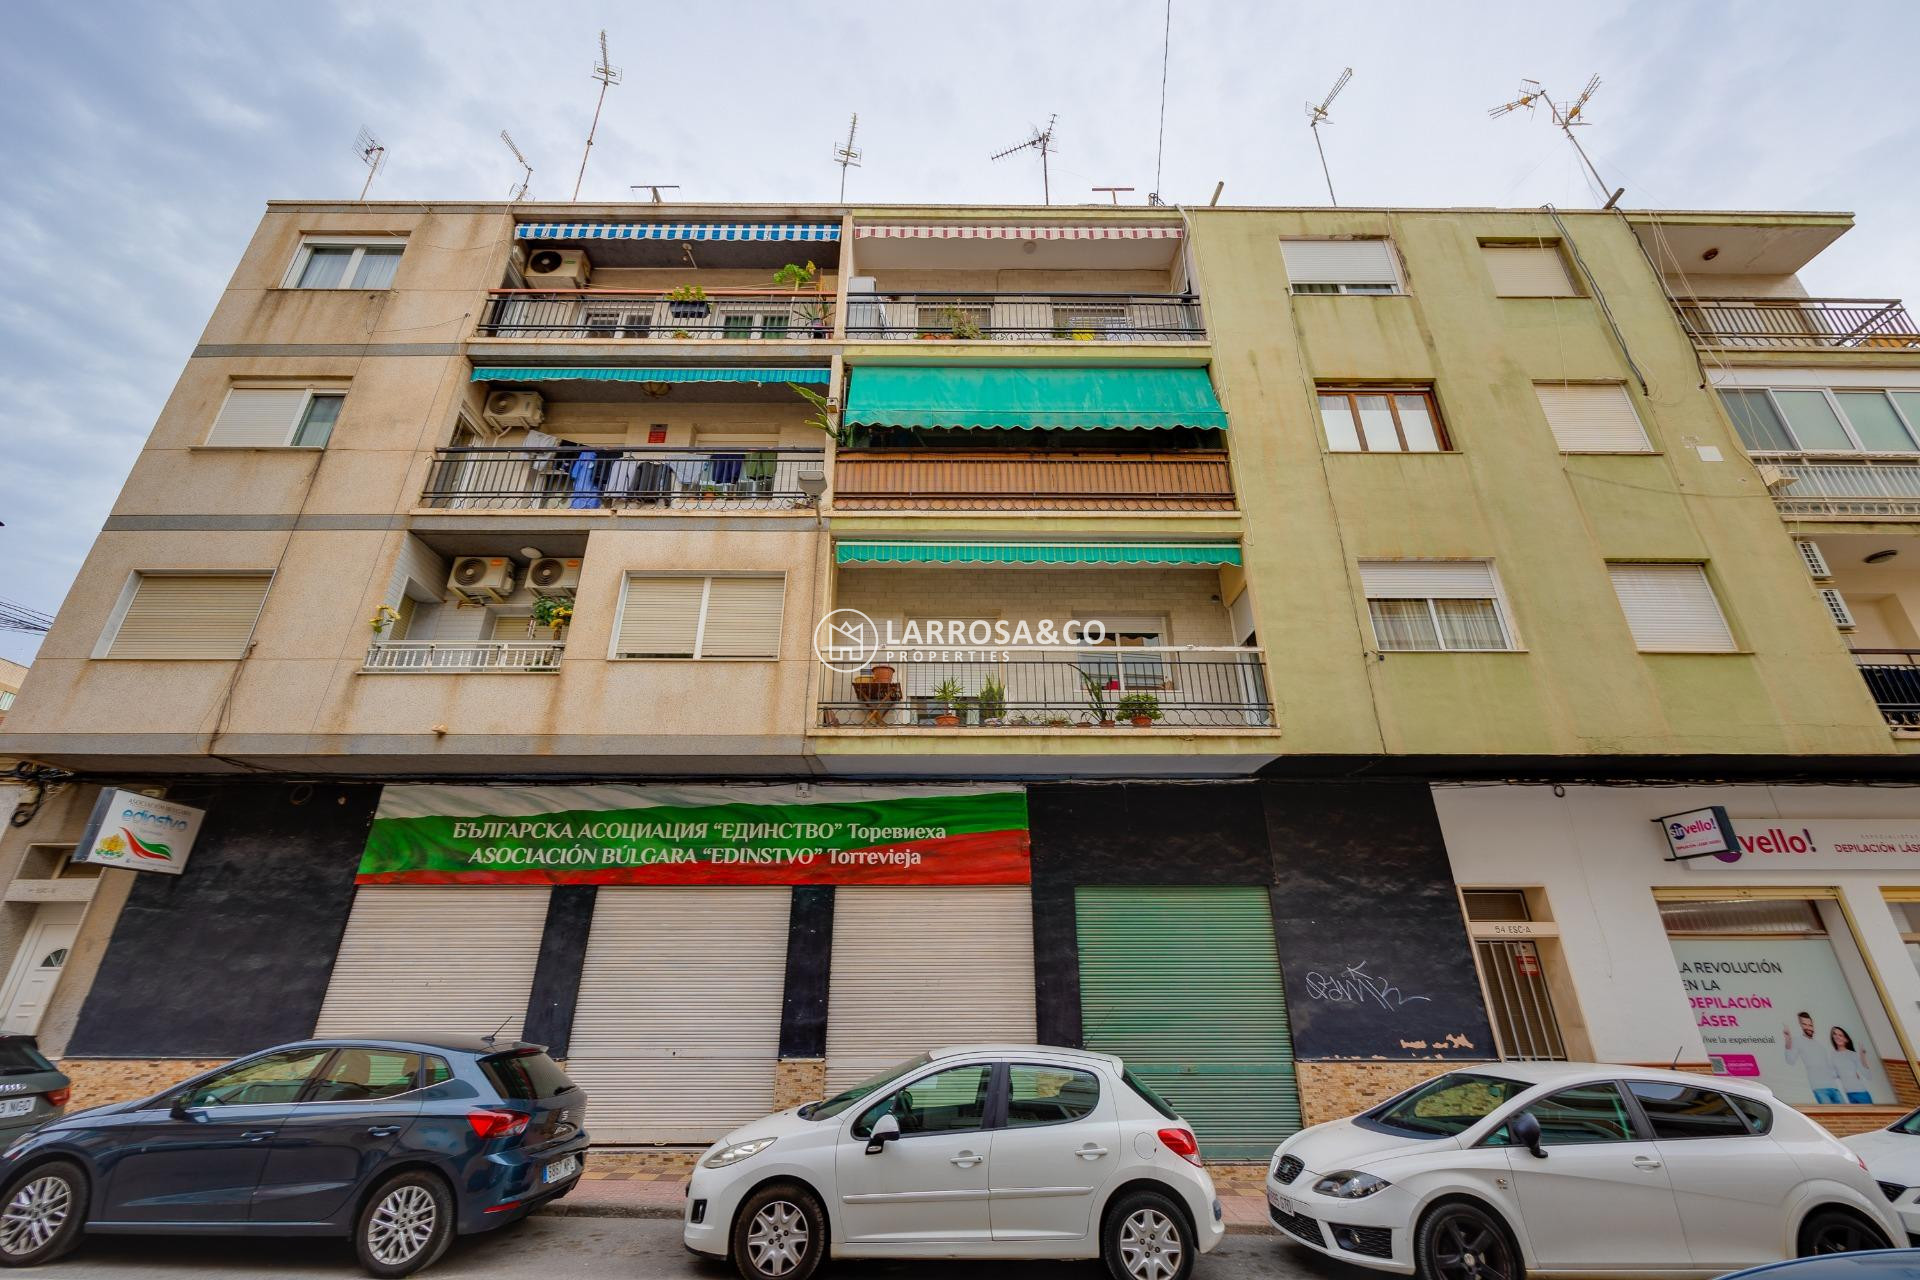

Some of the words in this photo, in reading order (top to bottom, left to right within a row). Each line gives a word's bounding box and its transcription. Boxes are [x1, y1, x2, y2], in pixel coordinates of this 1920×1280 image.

[453, 822, 573, 839] БЪЛГАРСКА
[578, 822, 707, 842] АСОЦИАЦИЯ
[847, 823, 946, 842] Торевиеха
[1834, 841, 1897, 853] DEPILACIÓN
[468, 844, 597, 864] ASOCIACIÓN
[601, 845, 698, 864] BÚLGARA
[827, 848, 922, 868] Torrevieja
[1494, 925, 1506, 934] 54
[1693, 958, 1782, 973] REVOLUCIÓN
[1701, 980, 1721, 991] LA
